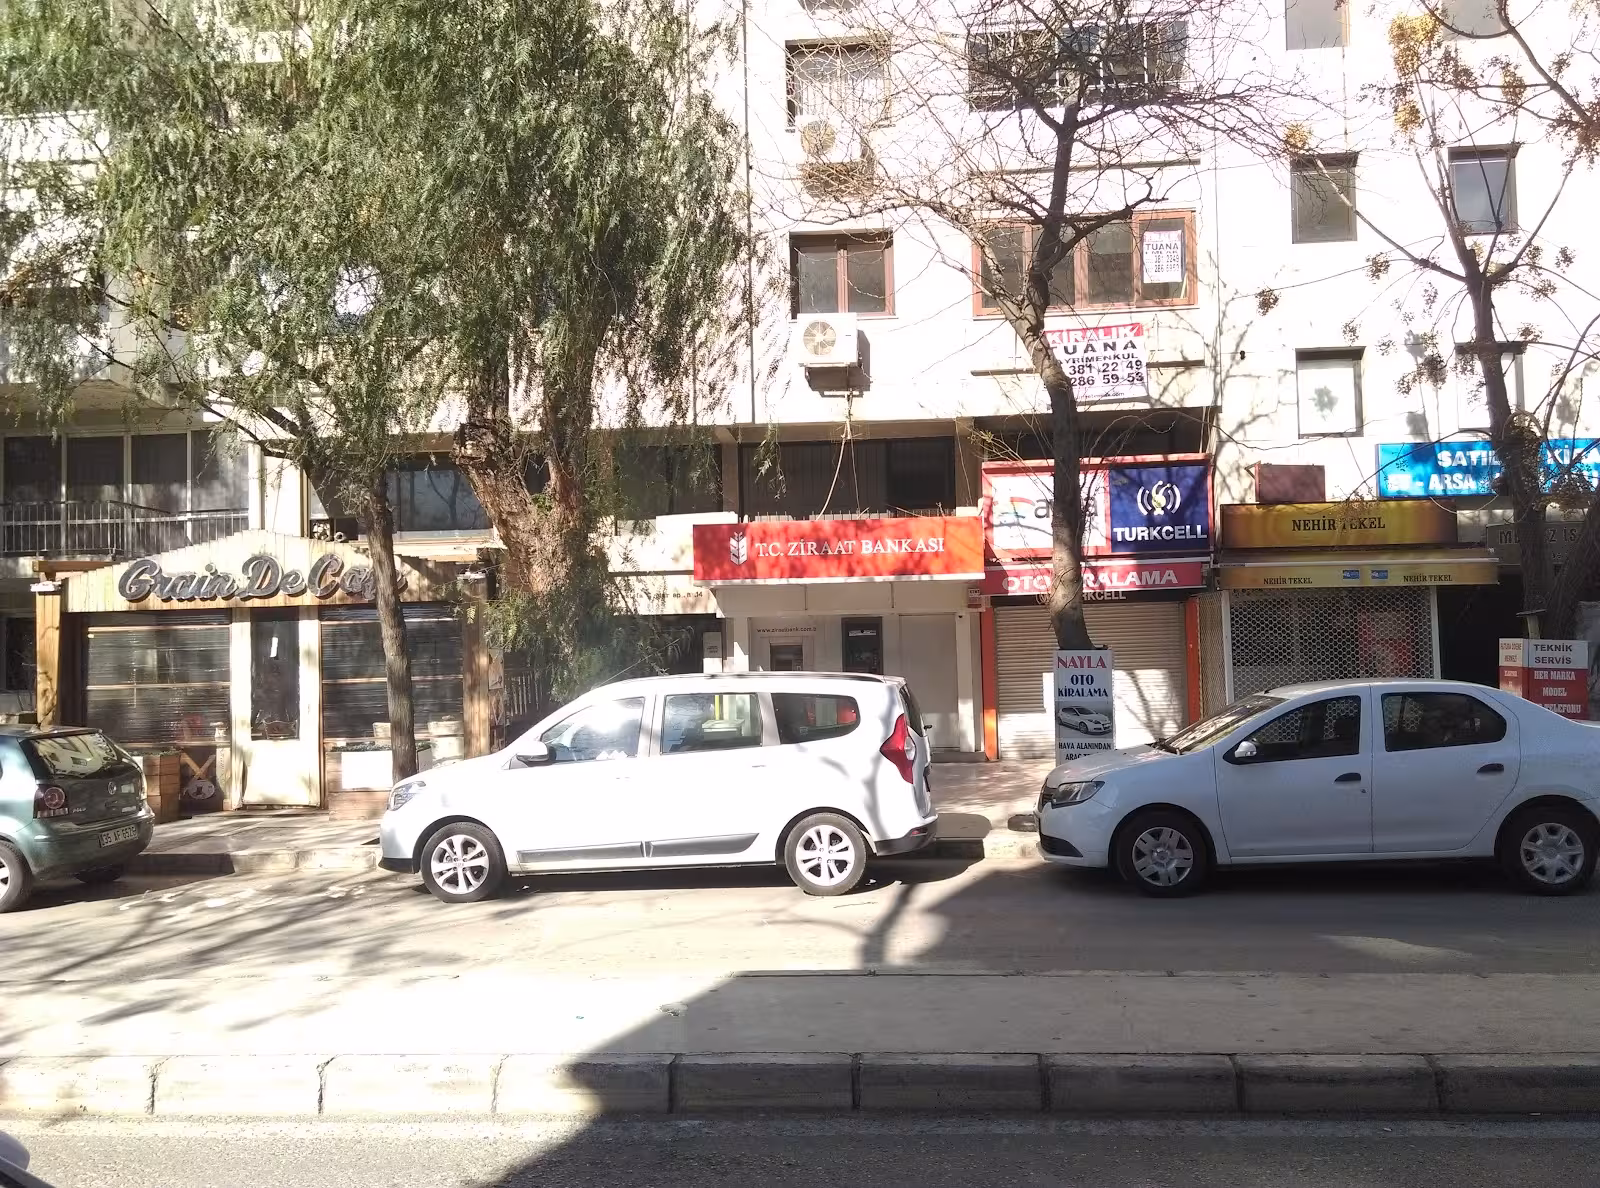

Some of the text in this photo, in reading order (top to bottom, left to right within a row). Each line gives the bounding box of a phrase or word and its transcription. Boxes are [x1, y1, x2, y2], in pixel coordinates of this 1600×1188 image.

[1068, 359, 1142, 376] 381 22 49
[1070, 375, 1095, 387] 286
[1102, 373, 1119, 384] 59
[1429, 473, 1476, 491] ARSA
[1292, 516, 1336, 531] NEHİR
[1113, 525, 1208, 542] TURKCELL
[755, 538, 945, 556] T.C. ZİRAAT BANKASI
[118, 558, 238, 601] Grain
[236, 554, 306, 600] De
[1082, 570, 1178, 587] RALAMA
[1263, 573, 1453, 585] NEHİR TEKEL NEHİR TEKEL
[1533, 643, 1573, 652] TEKNİK
[1057, 655, 1107, 669] NAYLA
[1534, 656, 1572, 665] SERVİS
[1070, 674, 1094, 686] OTO
[1534, 670, 1576, 681] HER MARKA
[1058, 686, 1109, 697] KİRALAMA
[1542, 687, 1568, 697] MODEL
[1058, 742, 1112, 750] HAVA ALANINDAN
